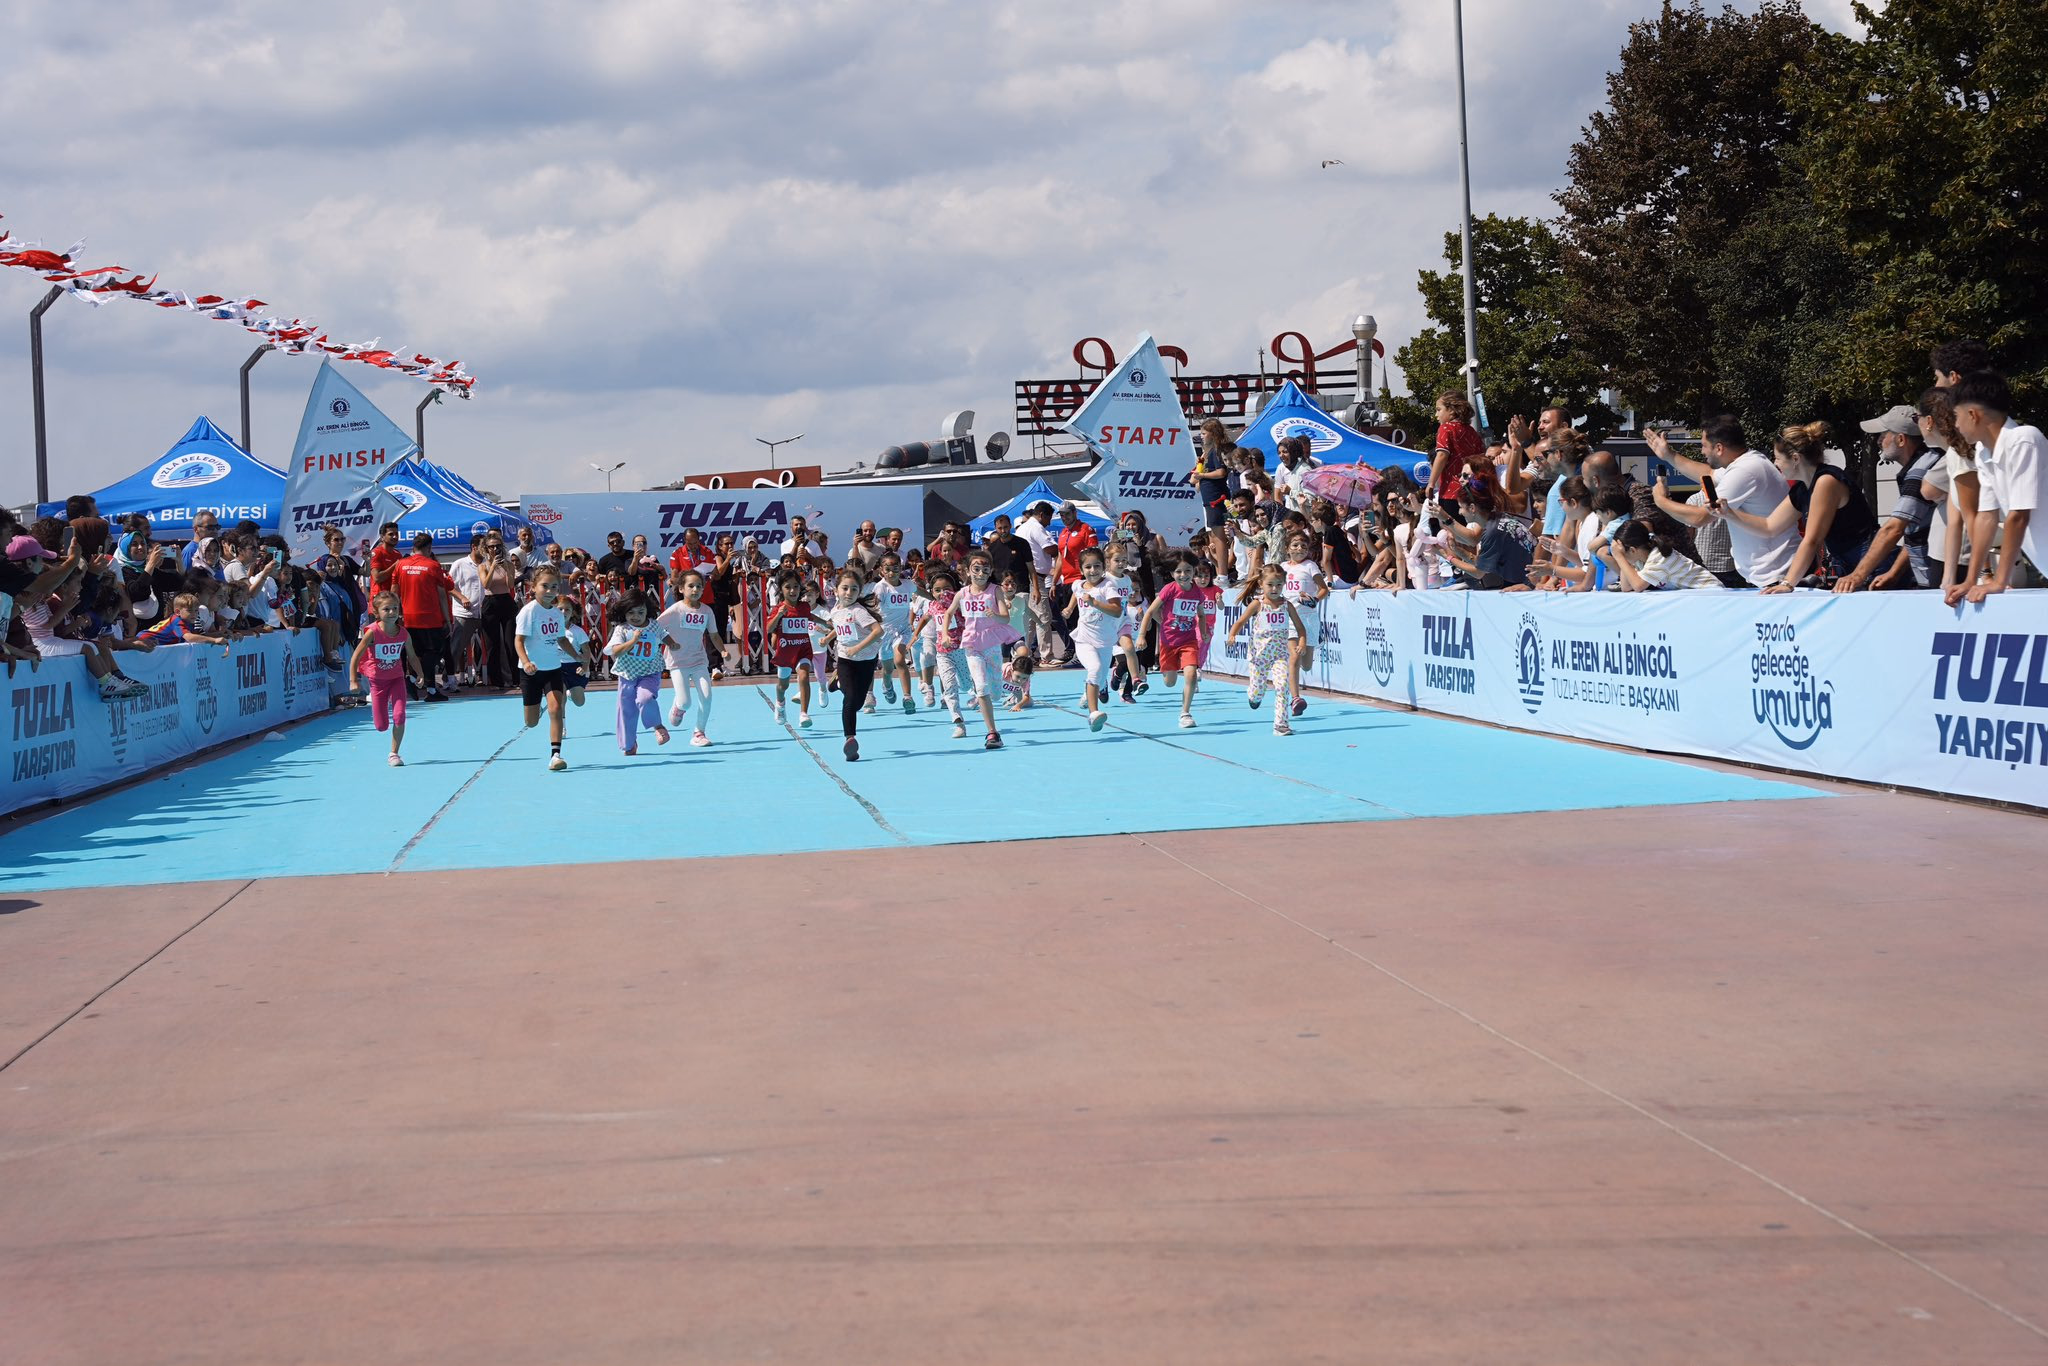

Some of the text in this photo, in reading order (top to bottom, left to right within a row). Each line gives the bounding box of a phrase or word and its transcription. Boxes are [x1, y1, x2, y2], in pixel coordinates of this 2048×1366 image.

[1099, 426, 1182, 446] START
[304, 448, 386, 473] FINISH
[1118, 470, 1196, 487] TUZLA
[1118, 488, 1196, 500] YARIŞIYOR
[292, 498, 374, 522] TUZLA
[528, 512, 564, 522] umutla
[658, 501, 788, 529] TUZLA
[890, 594, 908, 604] 064
[965, 601, 985, 612] 083
[1181, 600, 1197, 612] 073
[542, 622, 558, 635] 002
[686, 614, 705, 625] 084
[1266, 613, 1285, 624] 105
[1756, 616, 1795, 647] sporla
[382, 645, 401, 655] 067
[1422, 615, 1474, 660] TUZLA
[1552, 632, 1677, 679] AV. EREN ALİ BİNGÖL
[1752, 645, 1809, 686] geleceğe
[236, 652, 267, 690] TUZLA
[1425, 663, 1475, 695] YARIŞIYOR
[1931, 632, 2048, 708] TUZL
[1552, 678, 1680, 716] TUZLA BELEDİYE BAŞKANI
[1752, 676, 1834, 729] umutla
[12, 682, 75, 741] TUZLA
[1934, 714, 2048, 770] YARIŞIY
[12, 739, 76, 782] YARIŞIYOR
